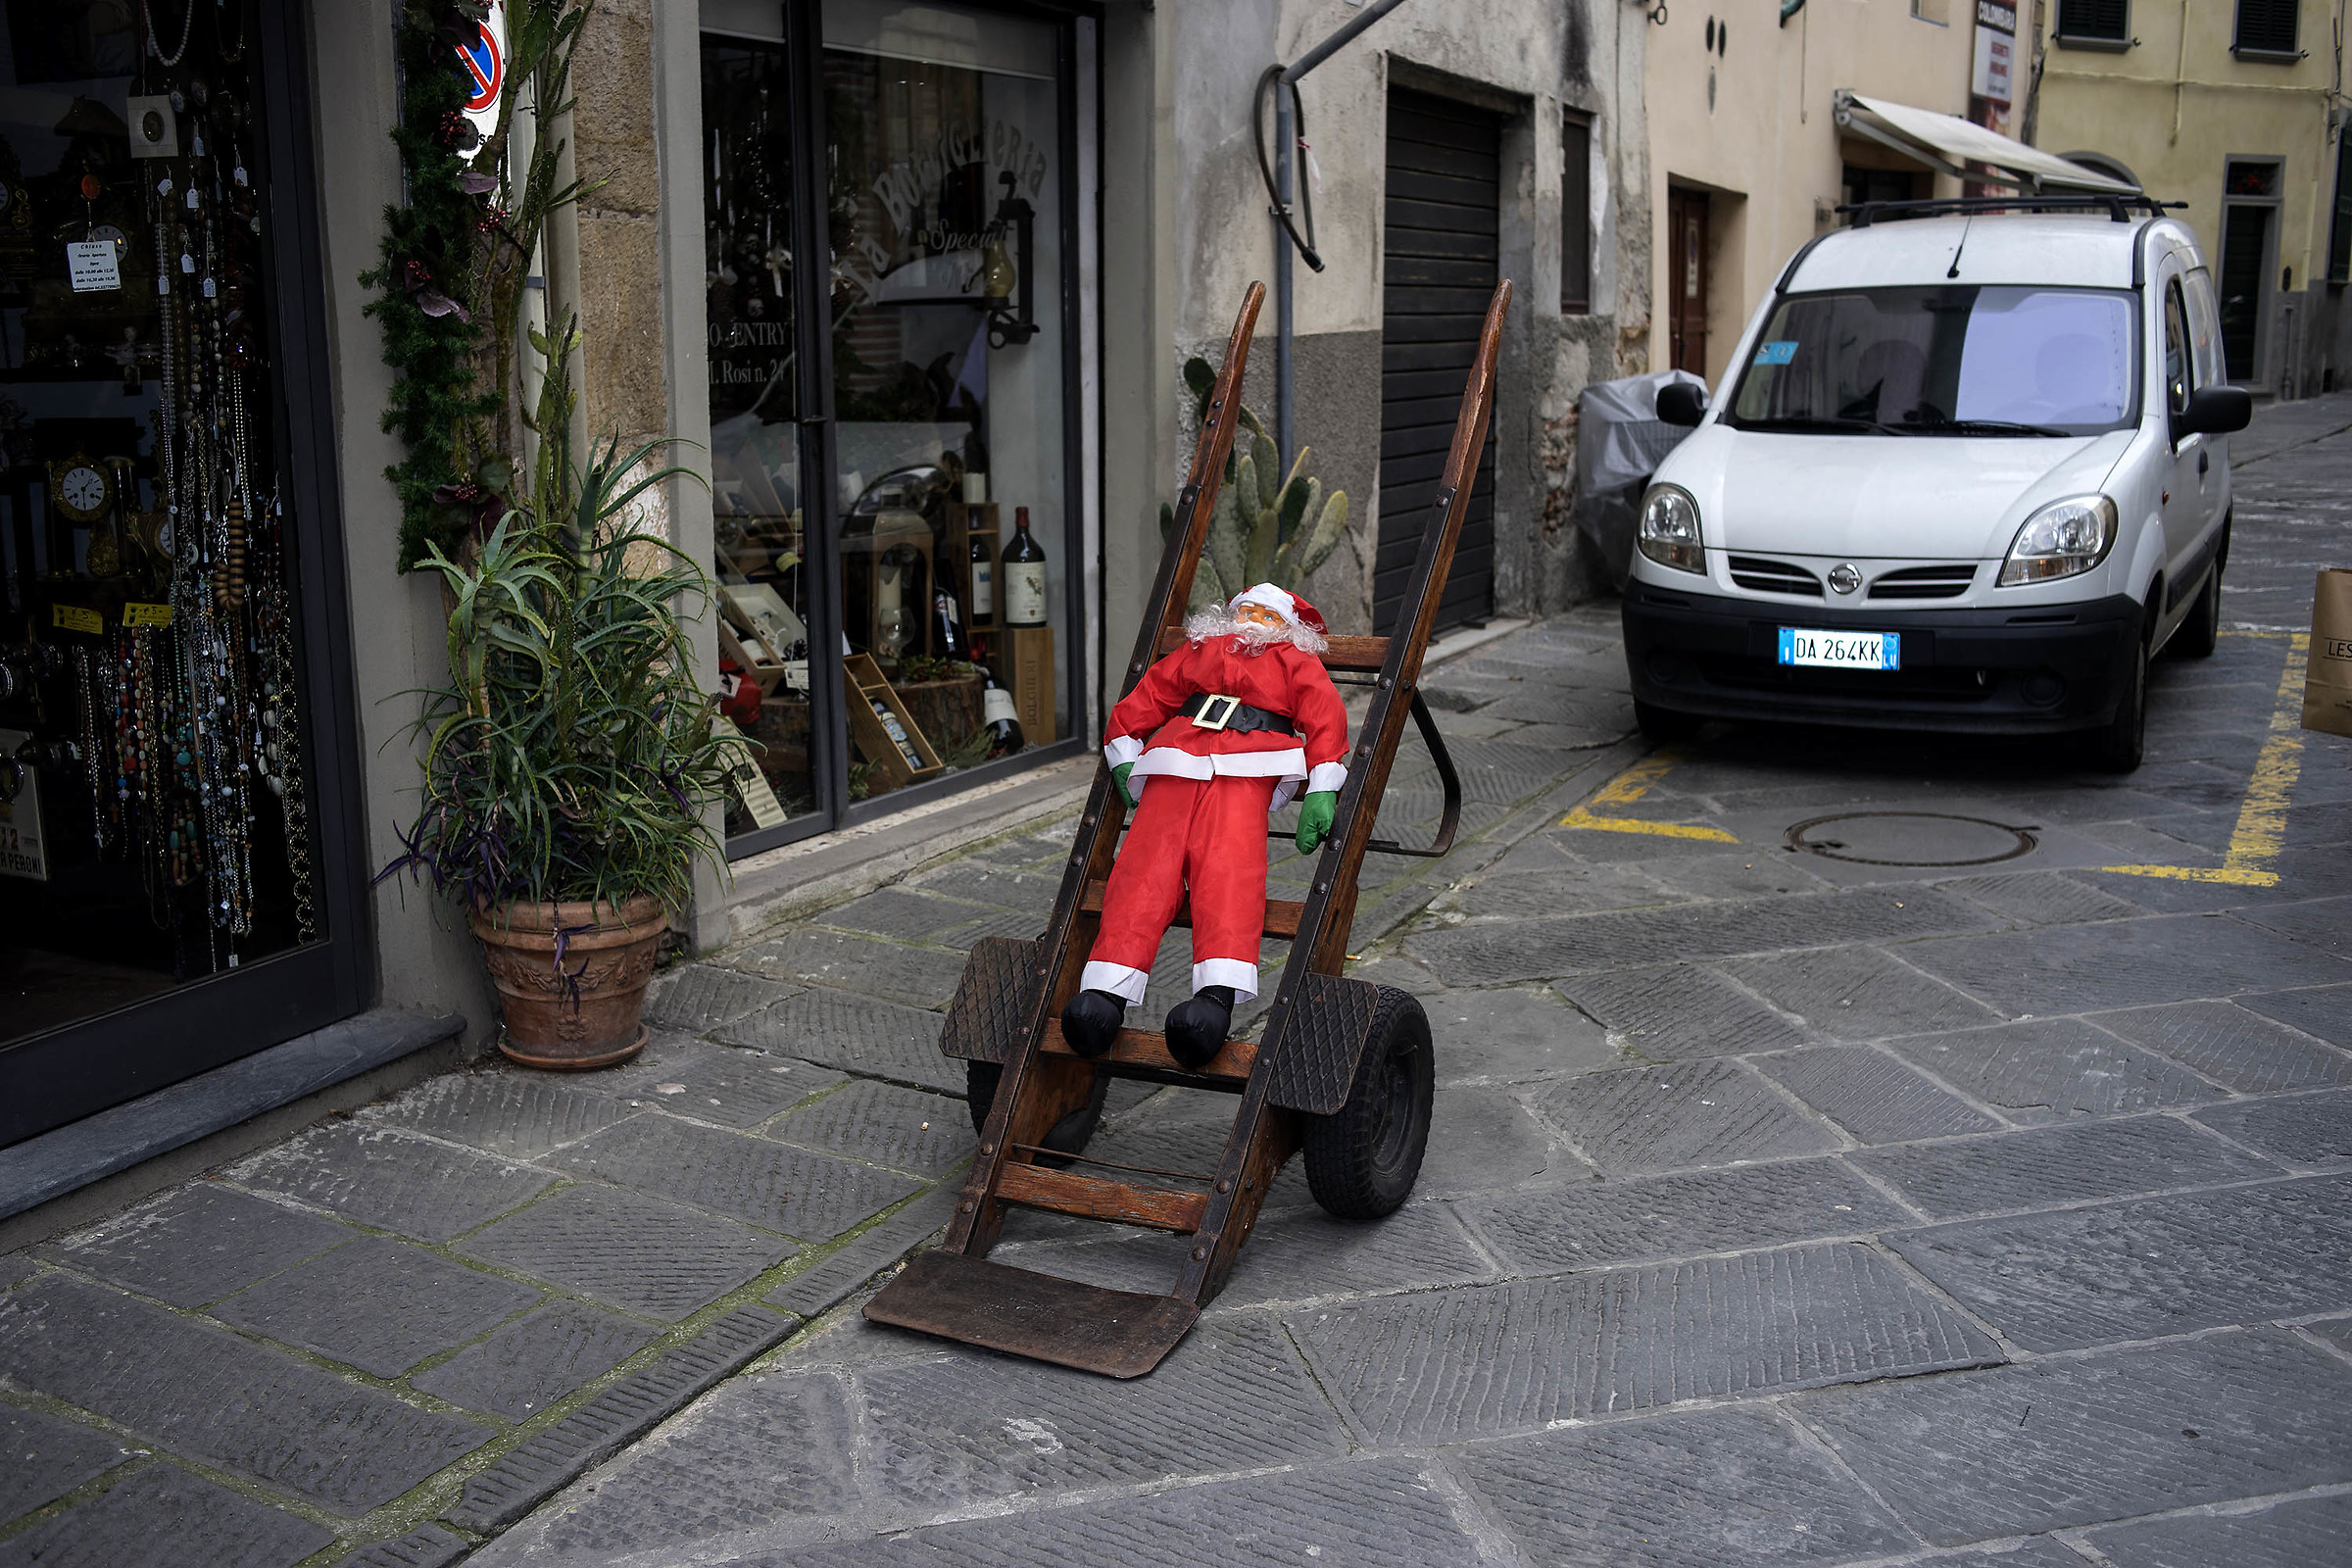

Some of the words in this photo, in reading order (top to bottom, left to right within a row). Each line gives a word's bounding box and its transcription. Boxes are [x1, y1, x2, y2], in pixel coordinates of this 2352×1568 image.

[733, 321, 788, 346] ENTRY
[1796, 638, 1816, 659] DA
[1824, 639, 1880, 662] 264KK
[1884, 653, 1897, 666] LU
[8, 853, 41, 875] PERONI
